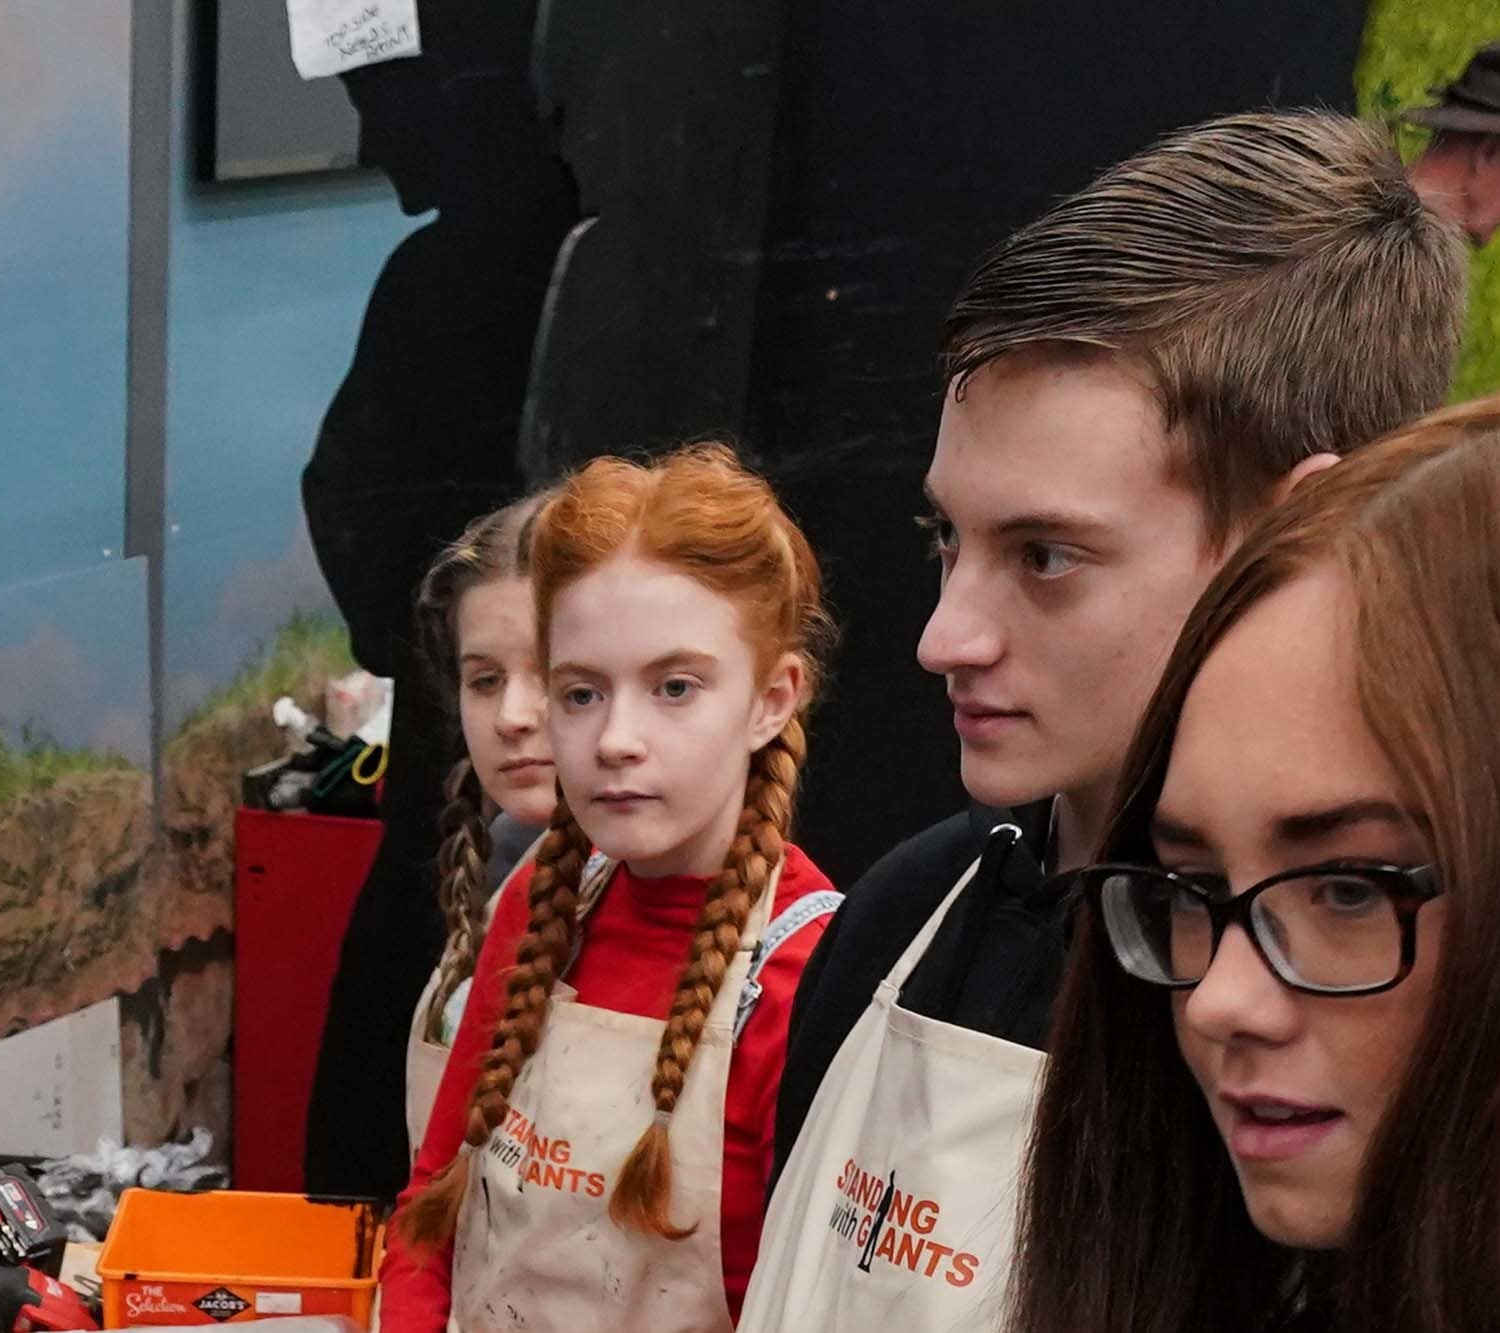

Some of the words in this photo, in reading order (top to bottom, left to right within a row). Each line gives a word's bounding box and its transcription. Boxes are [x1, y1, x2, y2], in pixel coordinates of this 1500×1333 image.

[490, 1136, 521, 1169] with
[829, 1202, 858, 1241] with
[141, 1285, 164, 1297] THE
[126, 1293, 187, 1318] Selection
[199, 1299, 246, 1311] JACOB'S
